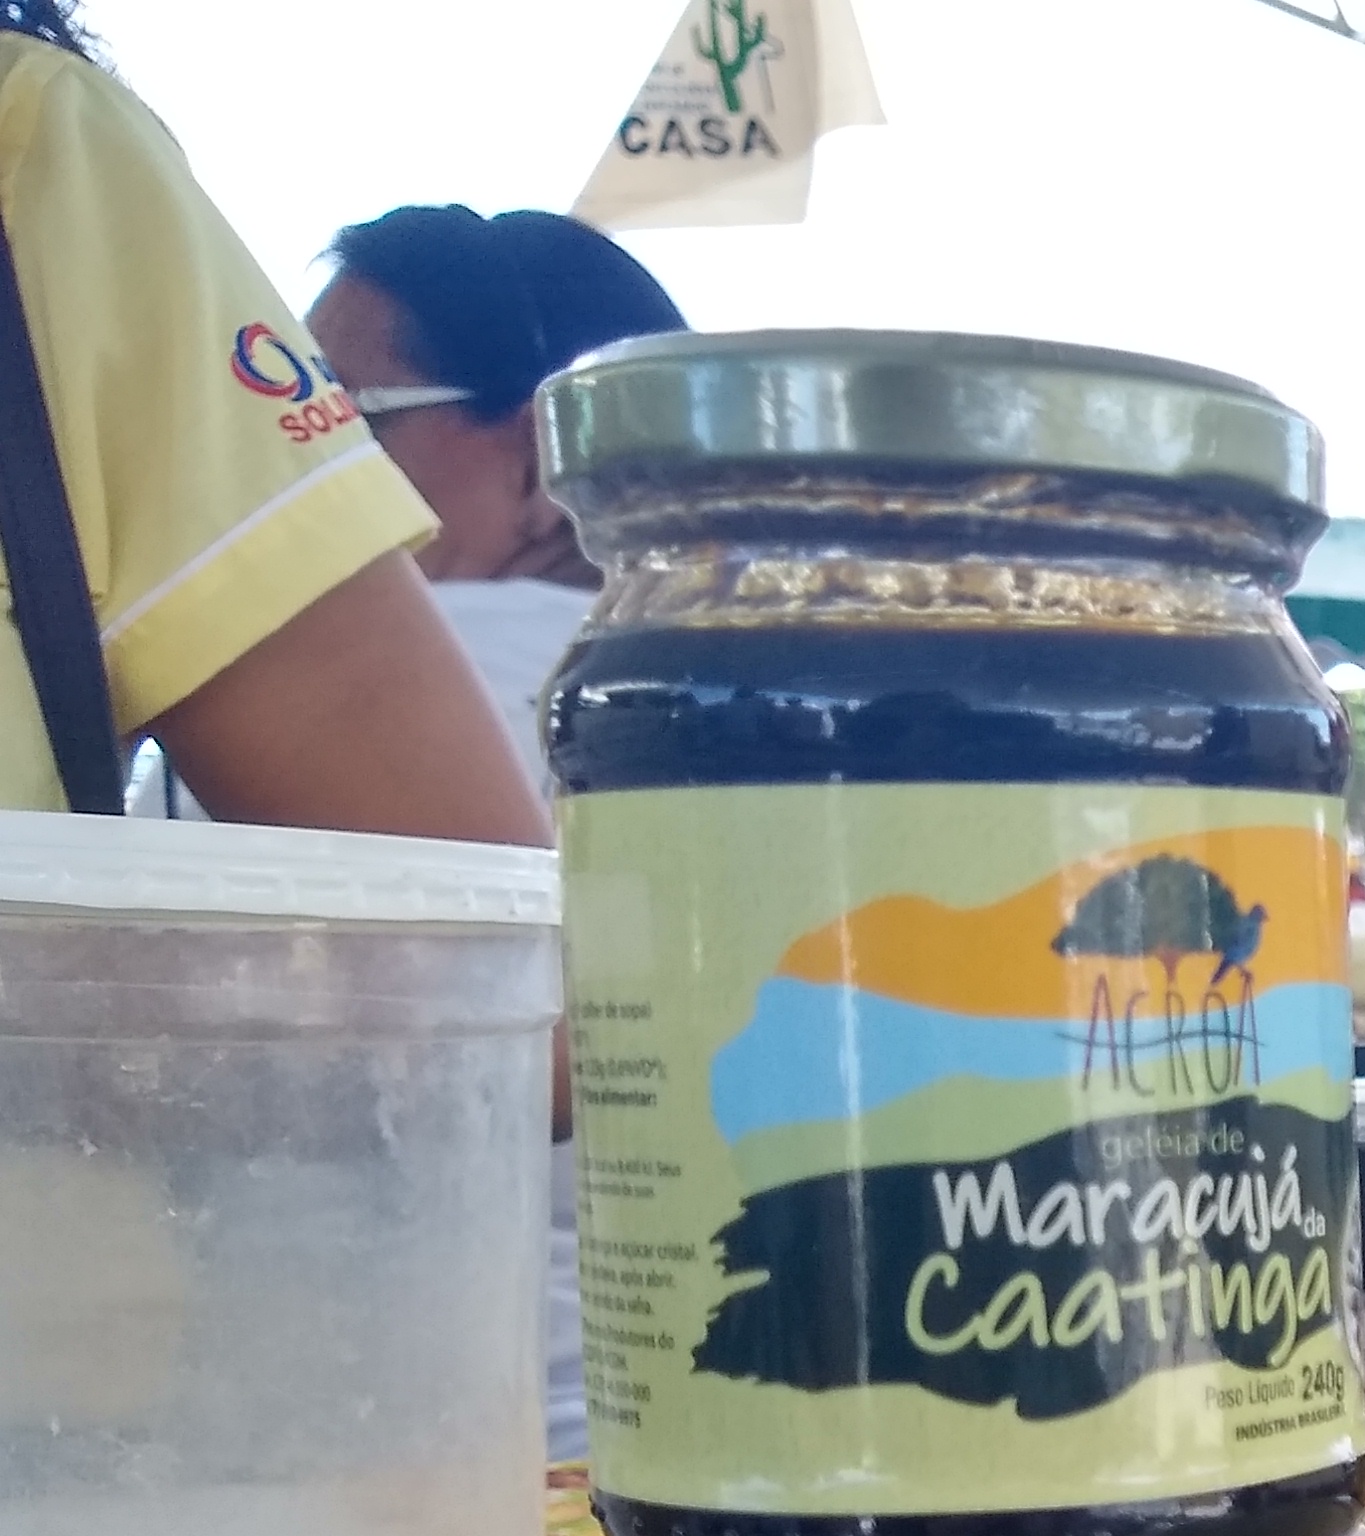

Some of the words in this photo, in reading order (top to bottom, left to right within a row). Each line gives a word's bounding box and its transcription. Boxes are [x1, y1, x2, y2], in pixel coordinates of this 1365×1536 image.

[620, 115, 781, 158] CASA
[1211, 1121, 1245, 1155] de
[1304, 1207, 1326, 1238] da
[905, 1238, 1332, 1367] Caatinga
[1204, 1385, 1243, 1410] Peso
[1248, 1374, 1296, 1405] Líquido
[1301, 1359, 1345, 1402] 240g
[1235, 1417, 1298, 1442] INDÚSTRIA
